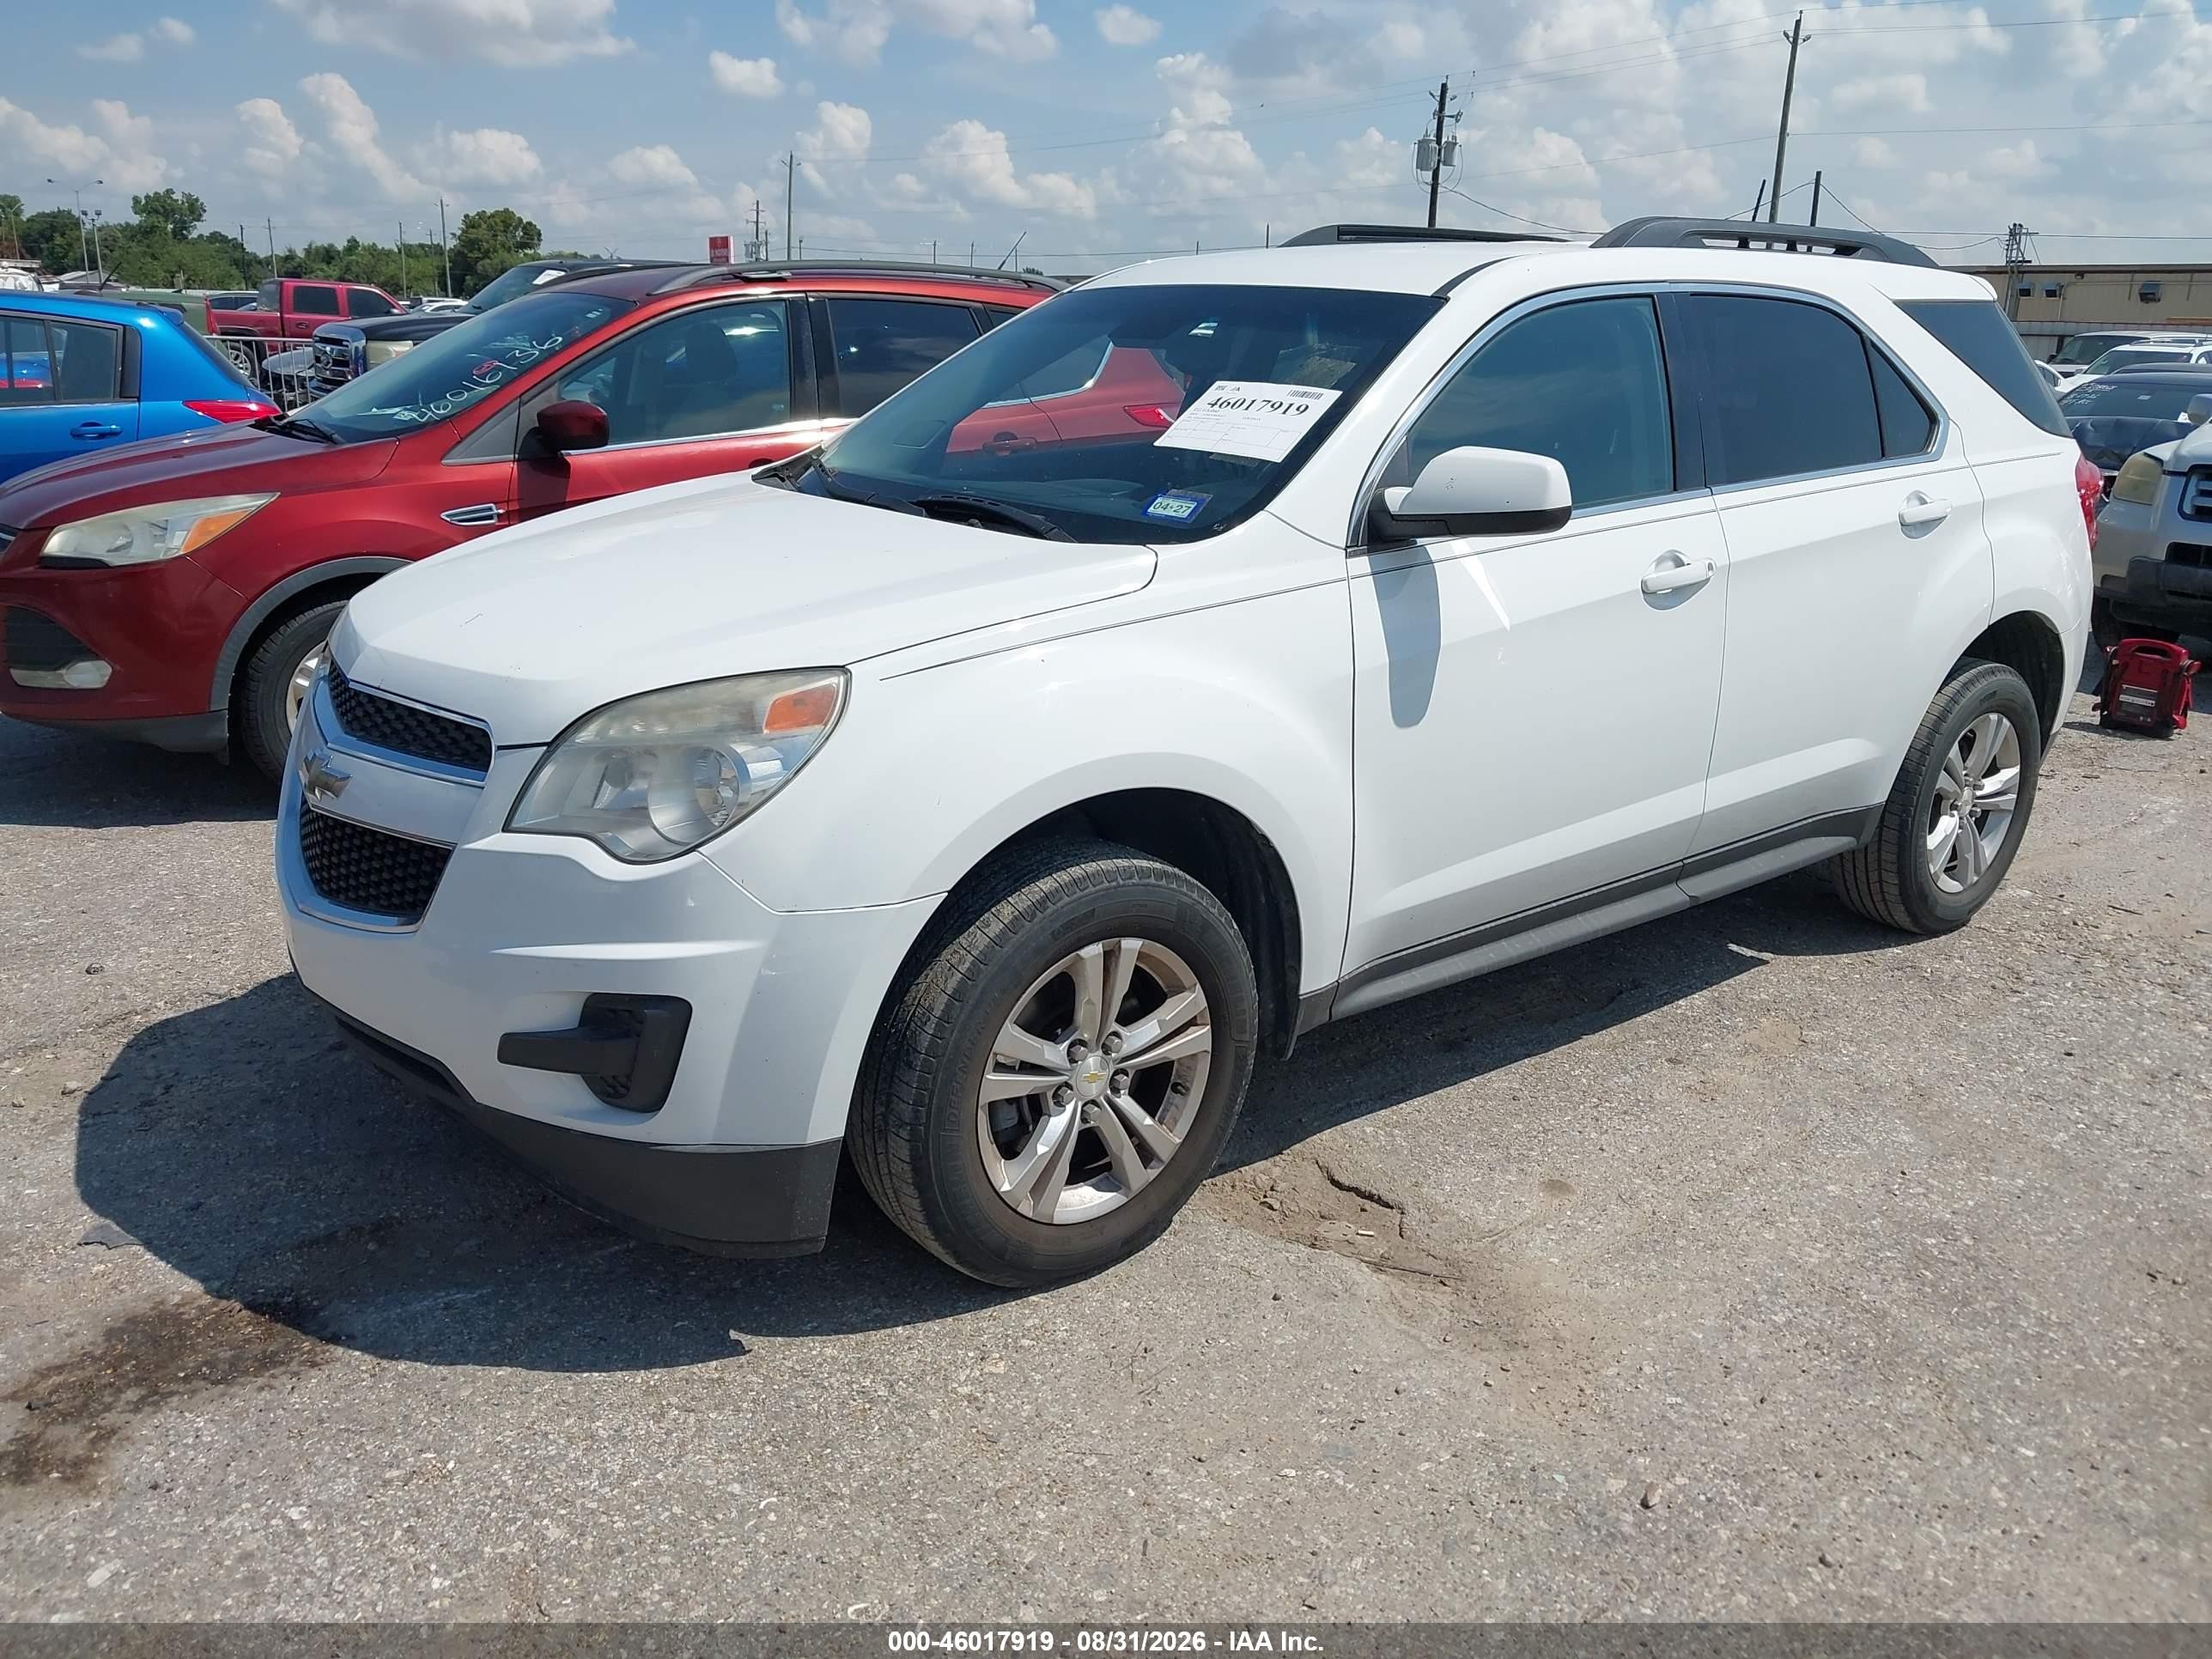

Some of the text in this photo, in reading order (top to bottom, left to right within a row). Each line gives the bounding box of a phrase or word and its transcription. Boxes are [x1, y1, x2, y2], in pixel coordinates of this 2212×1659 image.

[1206, 396, 1310, 416] 46017919
[1152, 501, 1193, 514] 04 27
